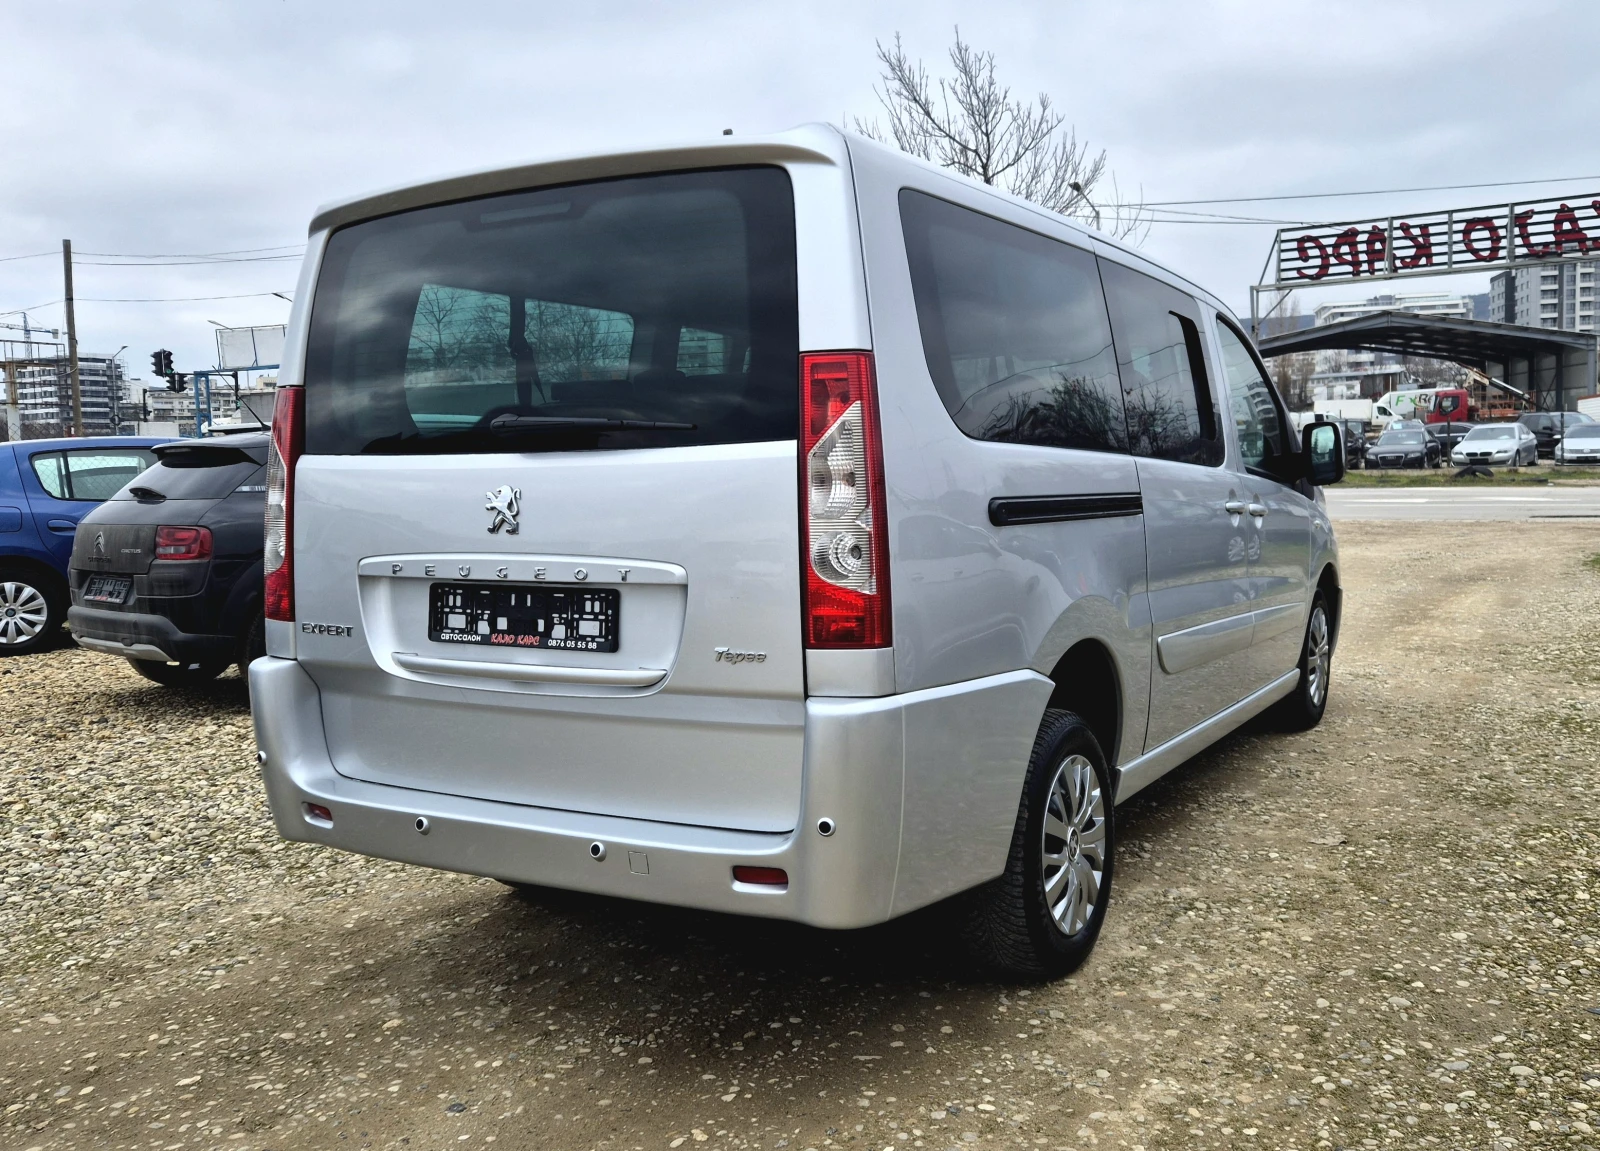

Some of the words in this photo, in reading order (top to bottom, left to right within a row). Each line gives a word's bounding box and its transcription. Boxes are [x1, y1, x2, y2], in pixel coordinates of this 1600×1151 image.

[391, 563, 632, 582] PEUGEOT
[302, 622, 354, 638] EXPERT
[516, 634, 540, 646] КАРС
[547, 639, 565, 648] 0876
[566, 640, 576, 648] 05
[577, 641, 586, 649] 55
[587, 641, 598, 650] 88
[714, 647, 767, 665] Tepee
